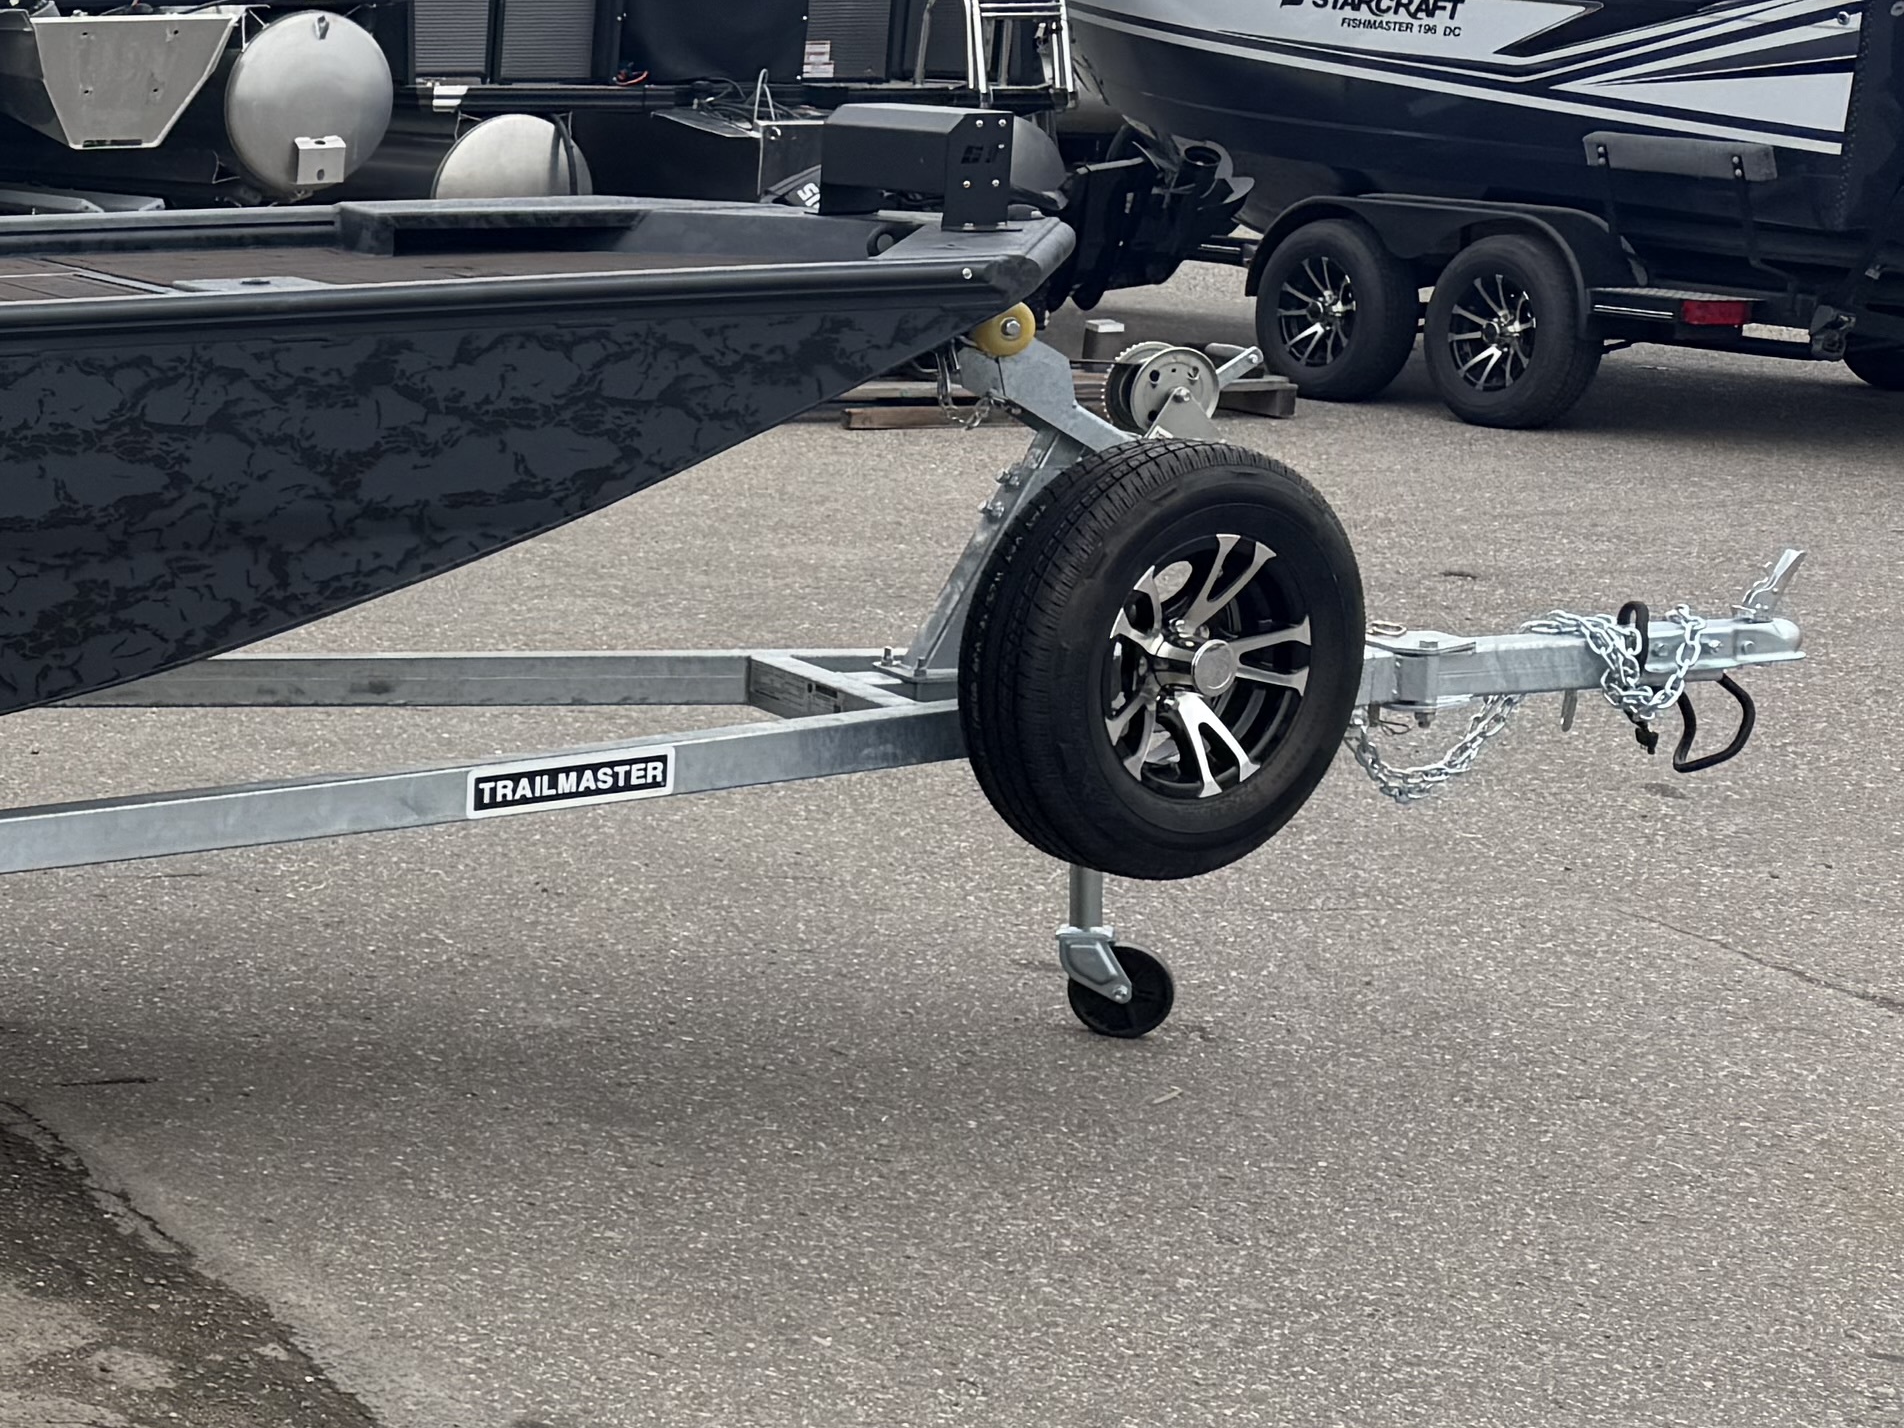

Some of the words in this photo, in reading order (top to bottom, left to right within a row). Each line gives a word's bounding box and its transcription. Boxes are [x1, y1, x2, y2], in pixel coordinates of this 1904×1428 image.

[1340, 17, 1414, 34] FISHMASTER
[1418, 23, 1438, 35] 196
[1443, 26, 1462, 37] DC
[478, 761, 665, 805] TRAILMASTER
